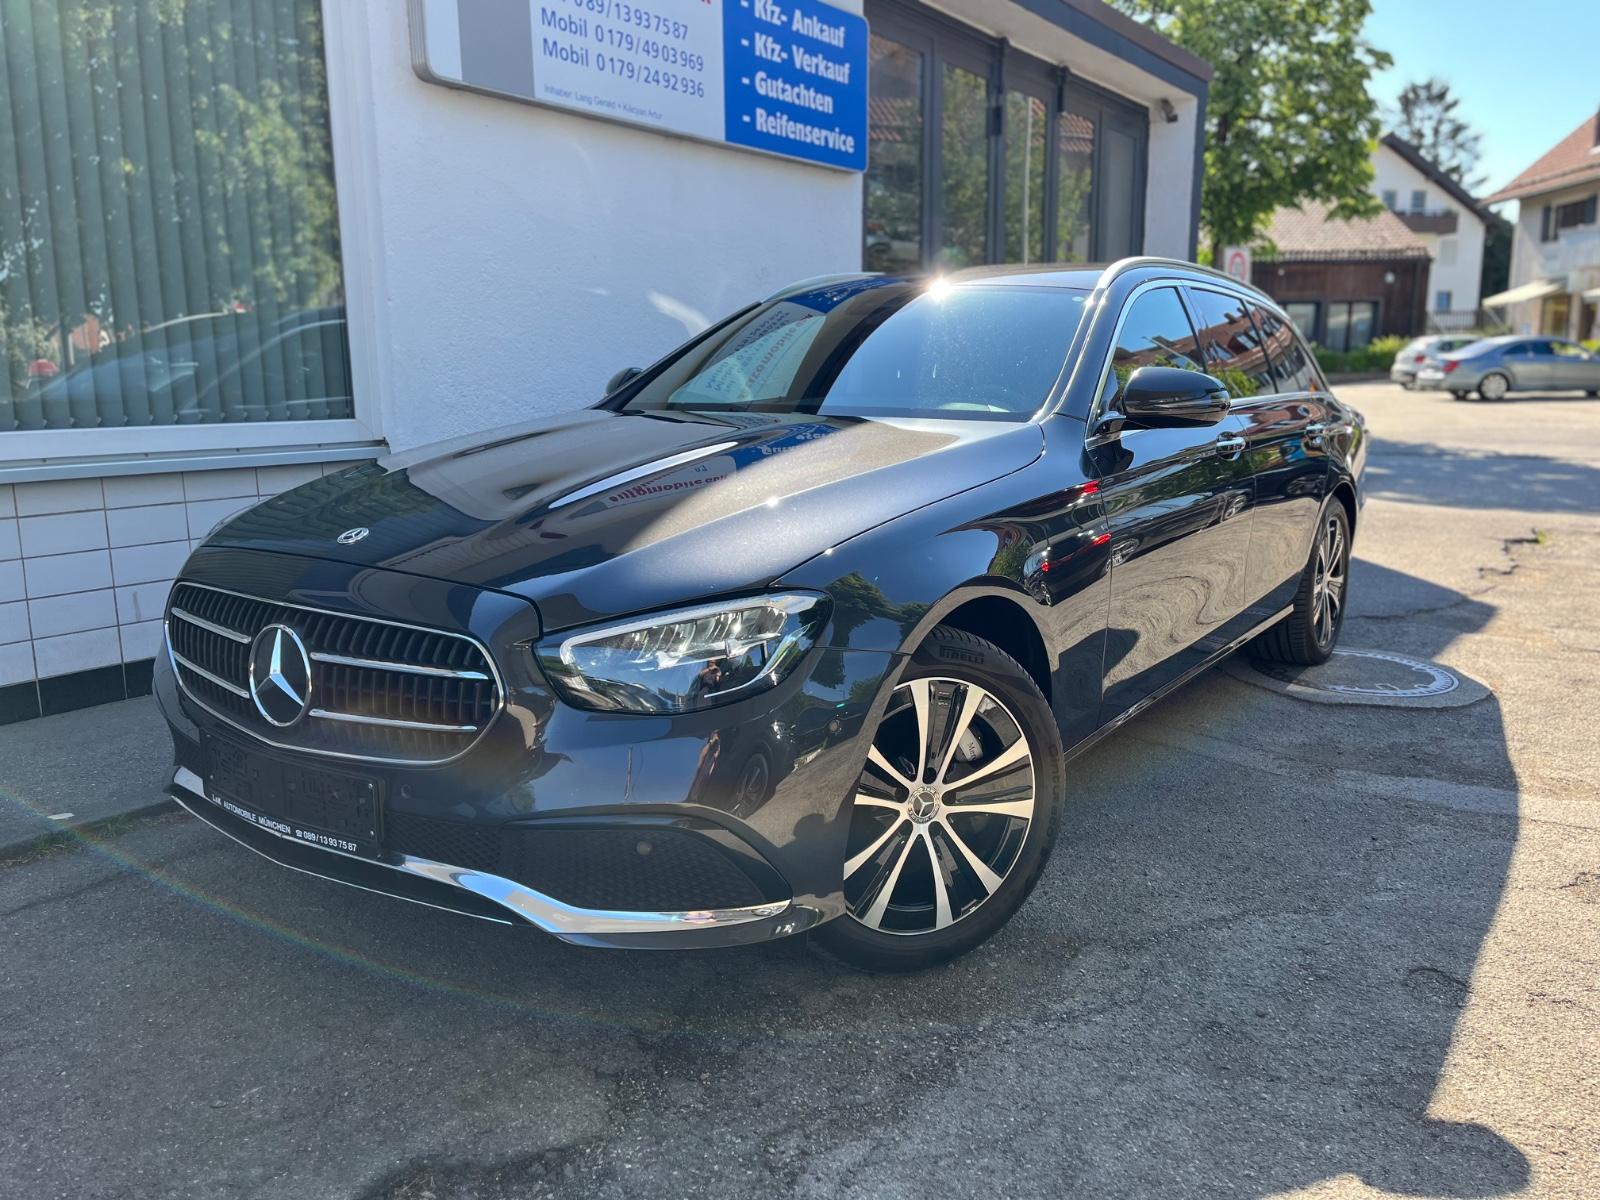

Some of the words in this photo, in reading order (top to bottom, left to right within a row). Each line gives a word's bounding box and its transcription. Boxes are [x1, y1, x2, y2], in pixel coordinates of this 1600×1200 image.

[541, 7, 588, 38] Mobil
[791, 9, 845, 48] Ankauf
[543, 37, 589, 67] Mobil
[754, 32, 788, 63] Kfz-
[791, 44, 850, 84] Verkauf
[755, 71, 833, 114] Gutachten
[755, 107, 855, 154] Reifenservice
[939, 645, 985, 665] PIRELLI
[223, 800, 257, 822] AUTOMOBILE
[258, 815, 291, 834] MÜNCHEN
